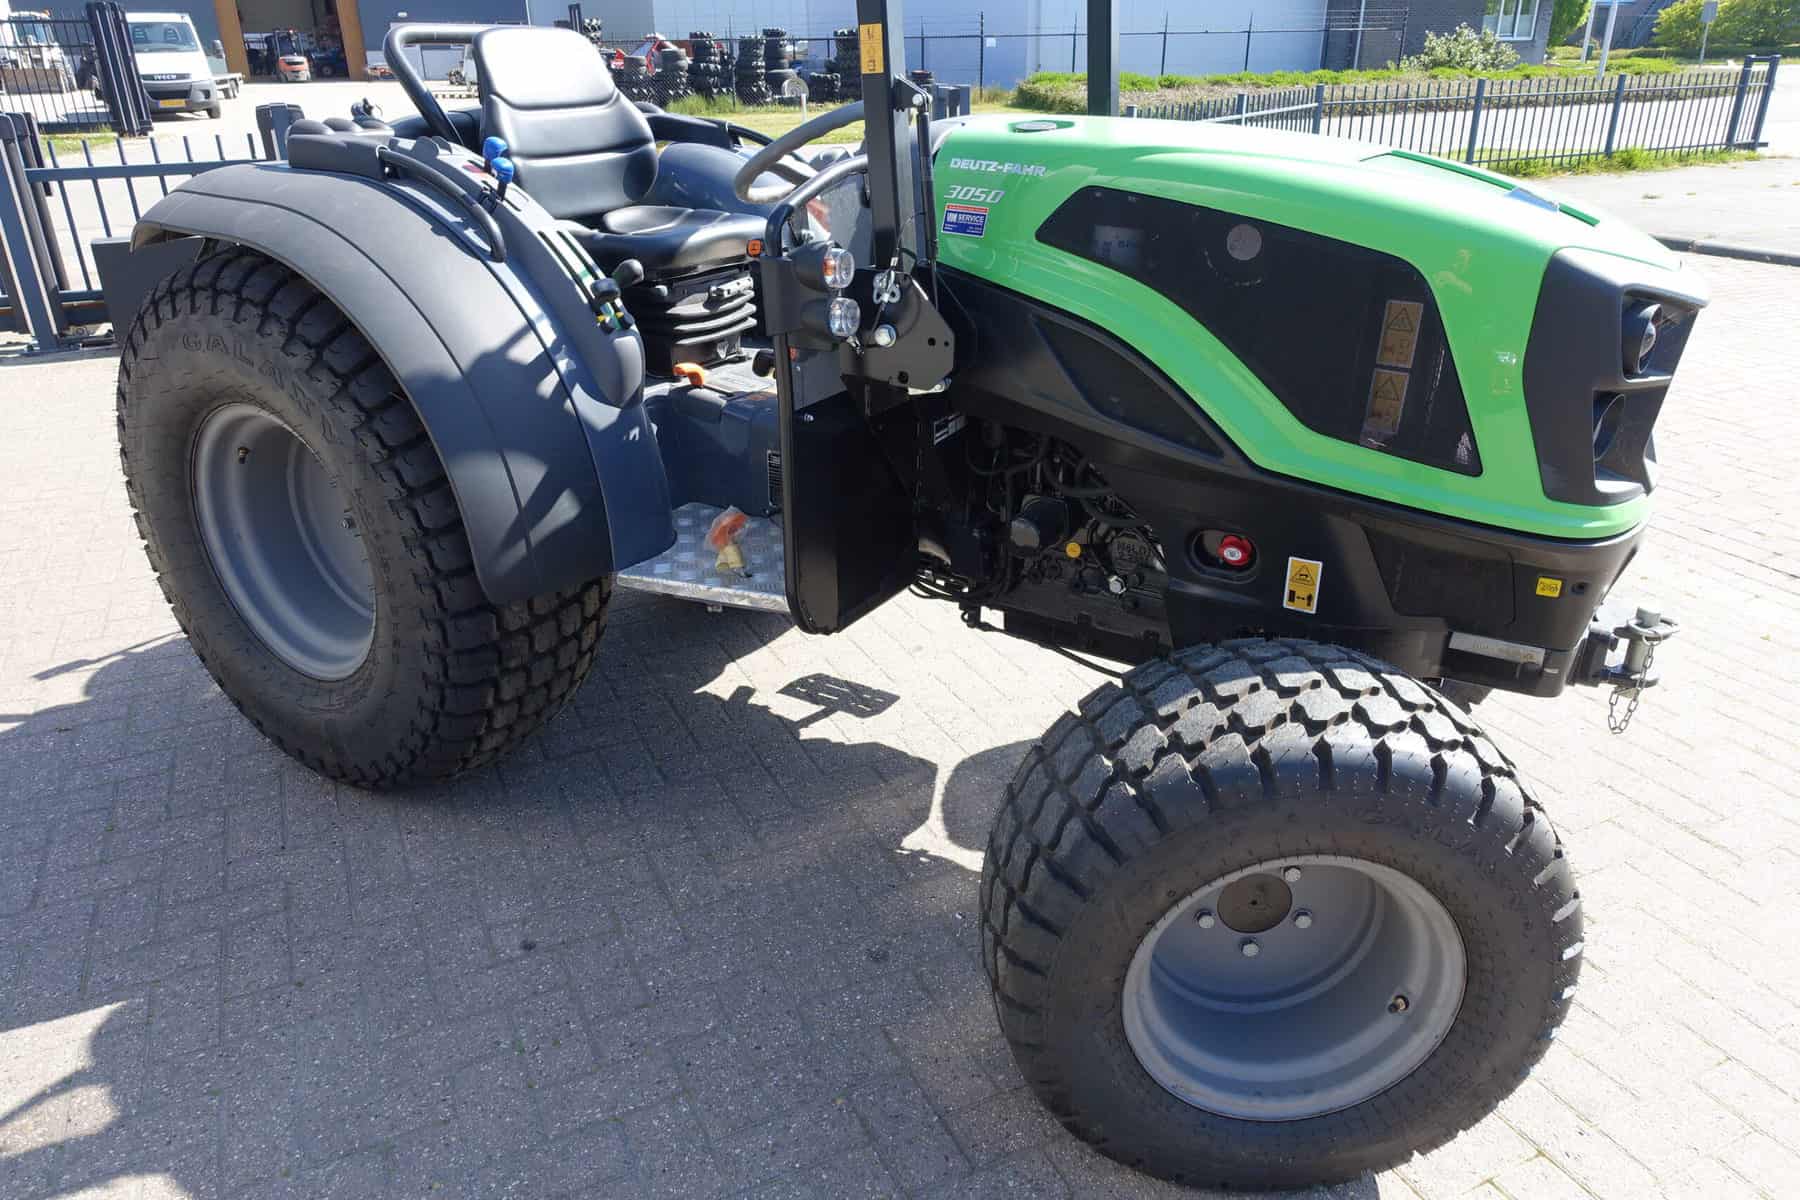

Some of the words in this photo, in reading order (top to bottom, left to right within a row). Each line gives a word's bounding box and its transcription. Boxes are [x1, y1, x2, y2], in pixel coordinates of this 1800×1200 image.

[949, 158, 1046, 177] DEUTZ-FAHR
[943, 185, 1005, 204] 3050
[958, 214, 985, 224] SERVICE
